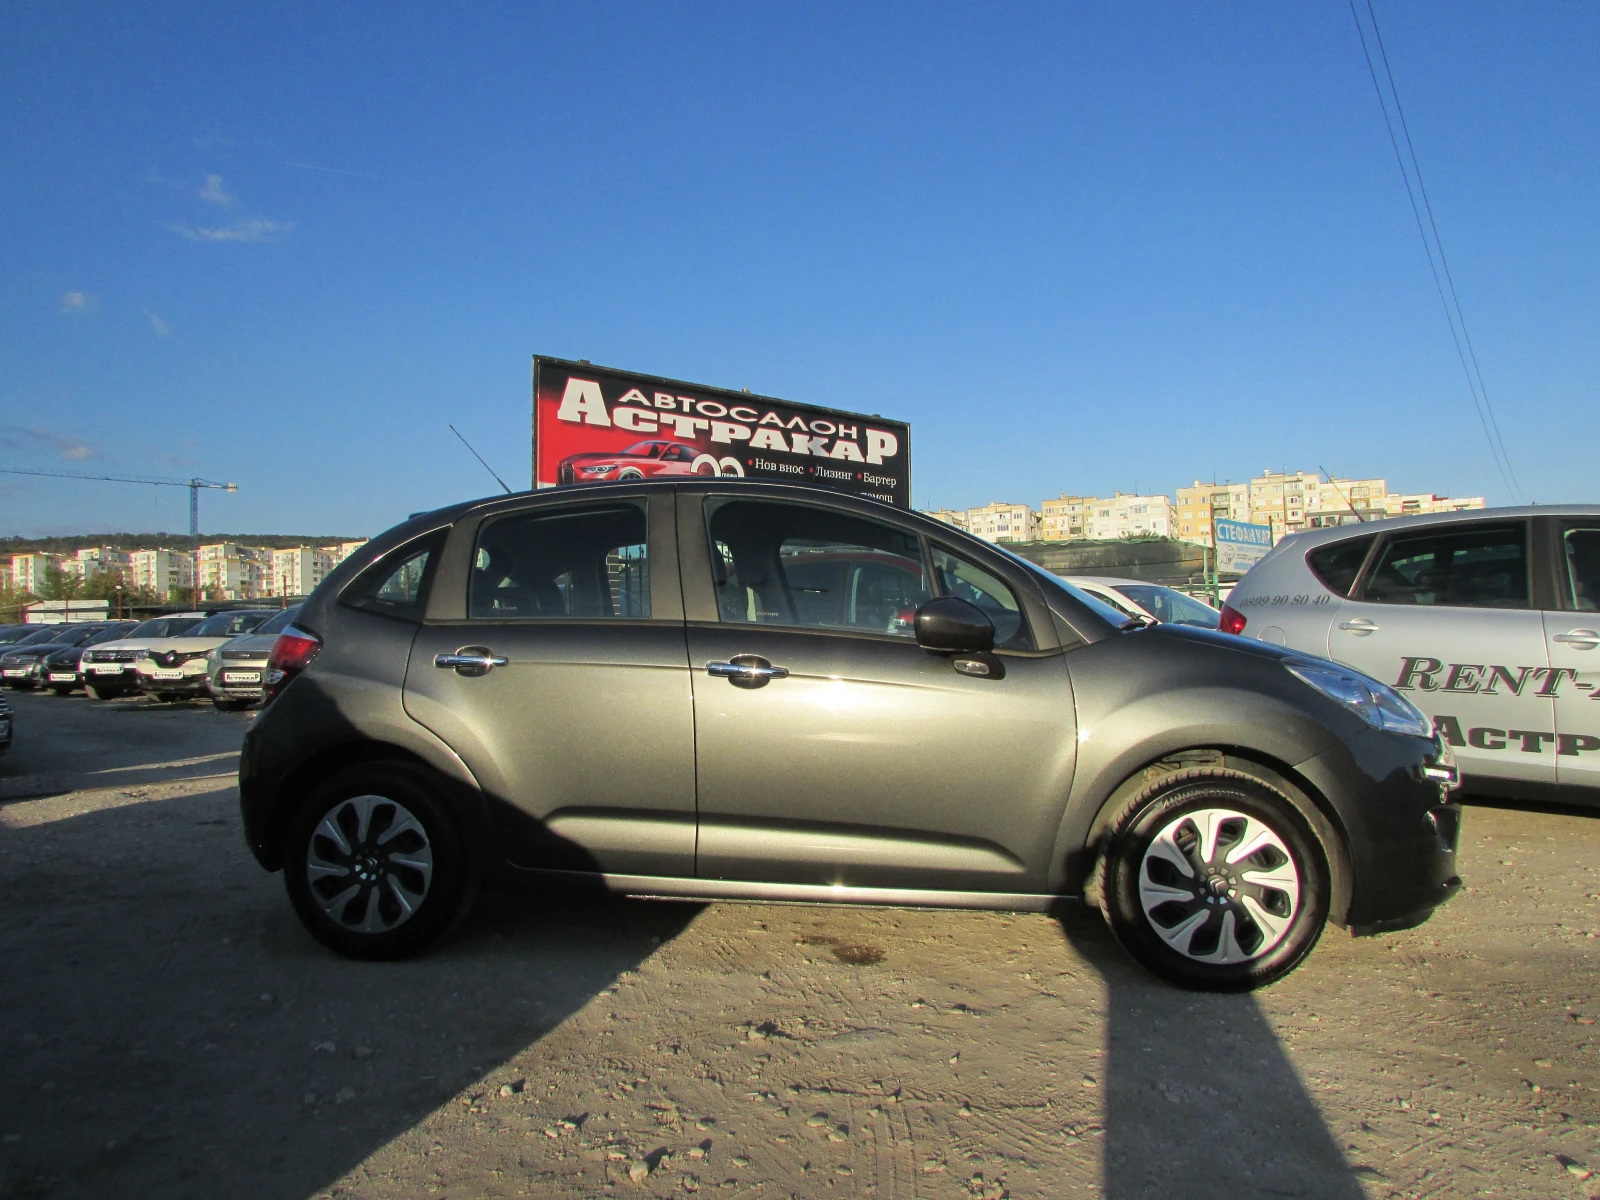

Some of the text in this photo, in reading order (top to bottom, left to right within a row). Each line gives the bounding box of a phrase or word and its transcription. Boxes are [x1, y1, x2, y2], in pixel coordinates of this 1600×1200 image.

[618, 388, 857, 439] АВТОСАЛОН
[755, 458, 777, 471] Нов
[779, 463, 804, 475] внос
[815, 466, 853, 480] Лизинг
[863, 472, 897, 487] Бартер
[1217, 523, 1256, 543] СТЕФАН
[1391, 656, 1600, 700] RENT-
